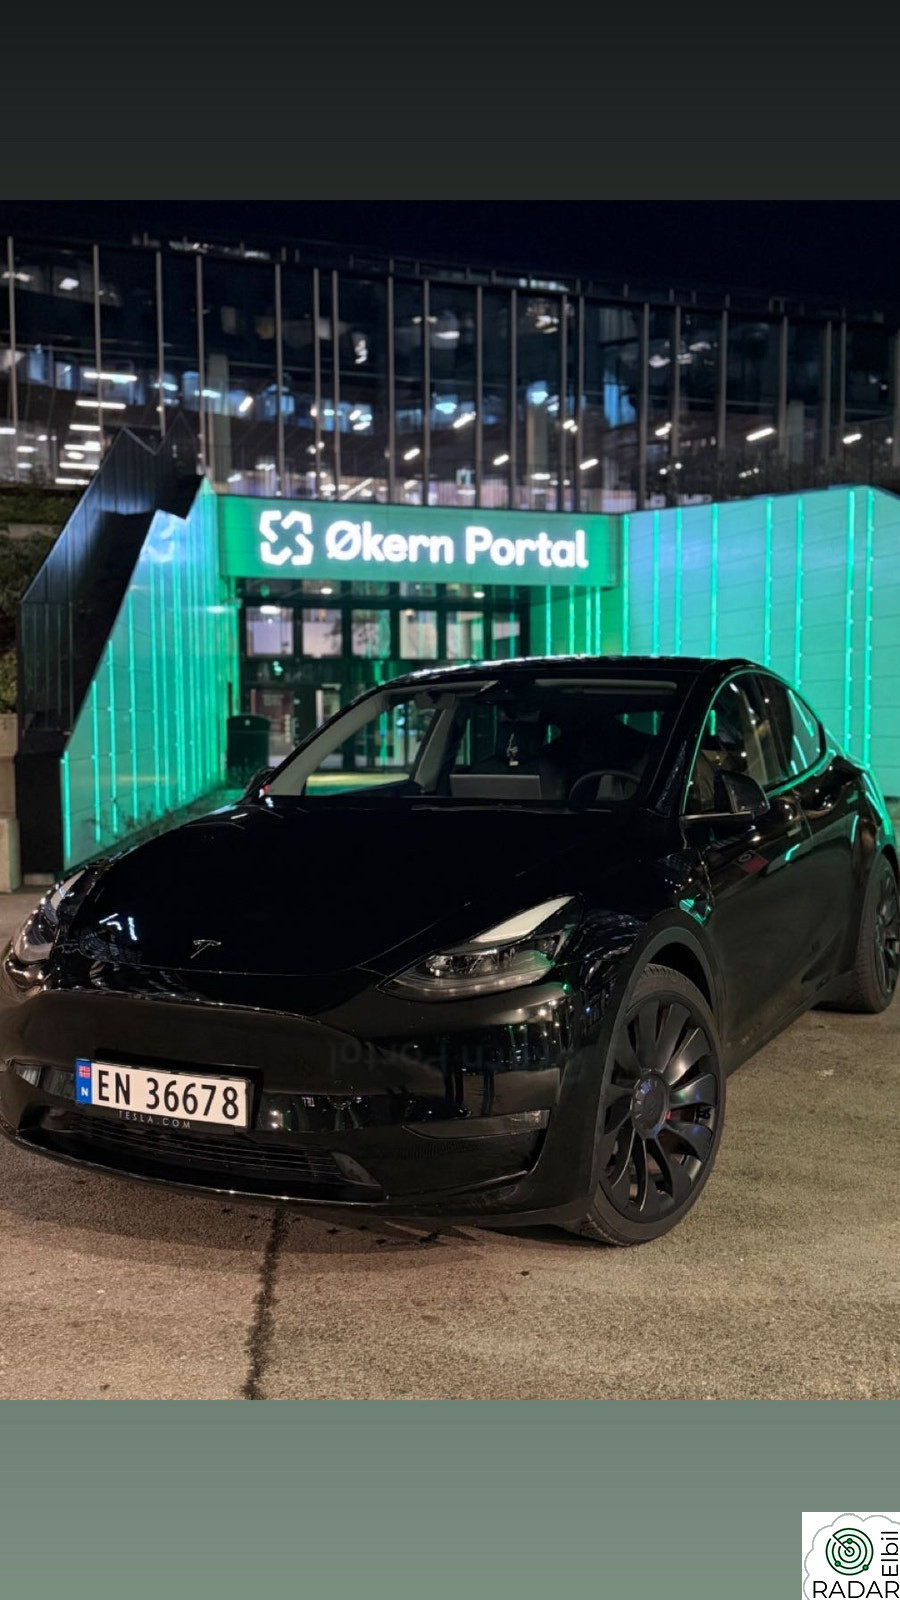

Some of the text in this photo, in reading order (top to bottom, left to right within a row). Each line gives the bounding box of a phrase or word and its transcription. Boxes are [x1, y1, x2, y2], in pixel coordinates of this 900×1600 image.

[324, 520, 589, 569] Økern Portal
[81, 1086, 89, 1097] N
[98, 1069, 239, 1120] EN 36678
[118, 1110, 191, 1129] TESLA.COM
